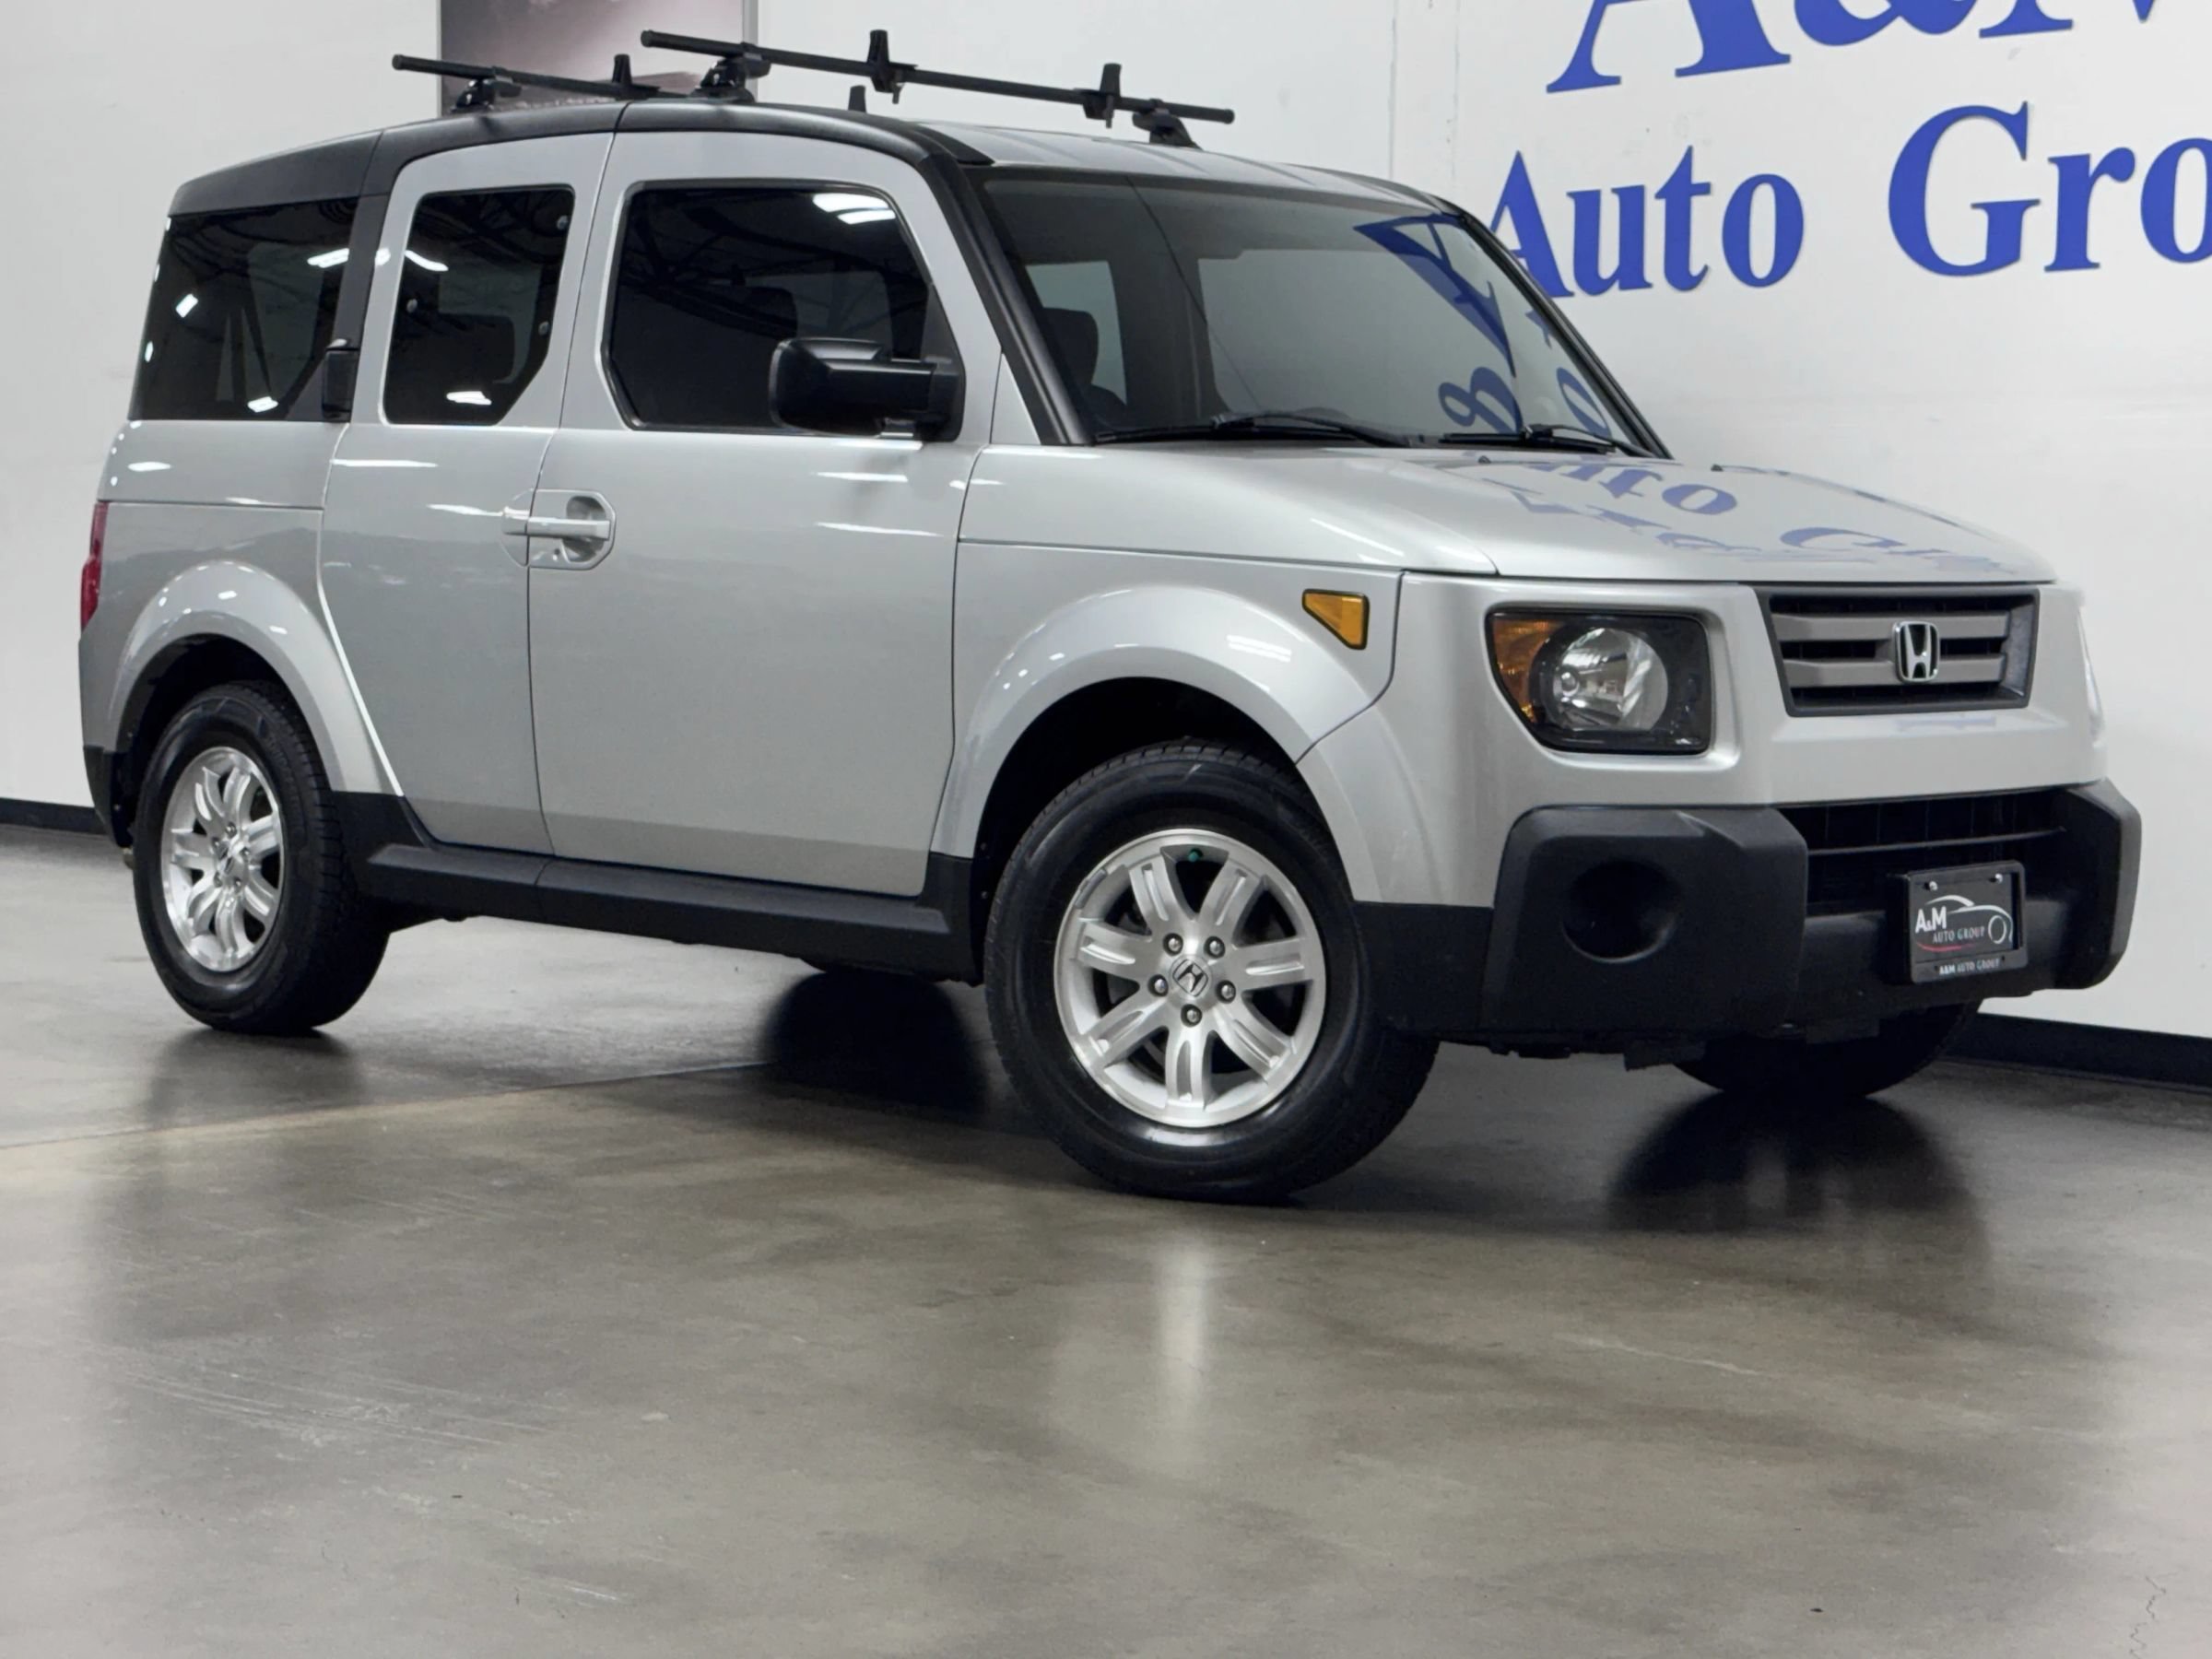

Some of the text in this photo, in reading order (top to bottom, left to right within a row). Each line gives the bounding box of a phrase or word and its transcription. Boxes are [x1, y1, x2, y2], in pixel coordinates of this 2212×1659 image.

[1488, 146, 1805, 298] Auto
[1914, 906, 1947, 934] A&M
[1933, 925, 1985, 944] AUTO GROUP
